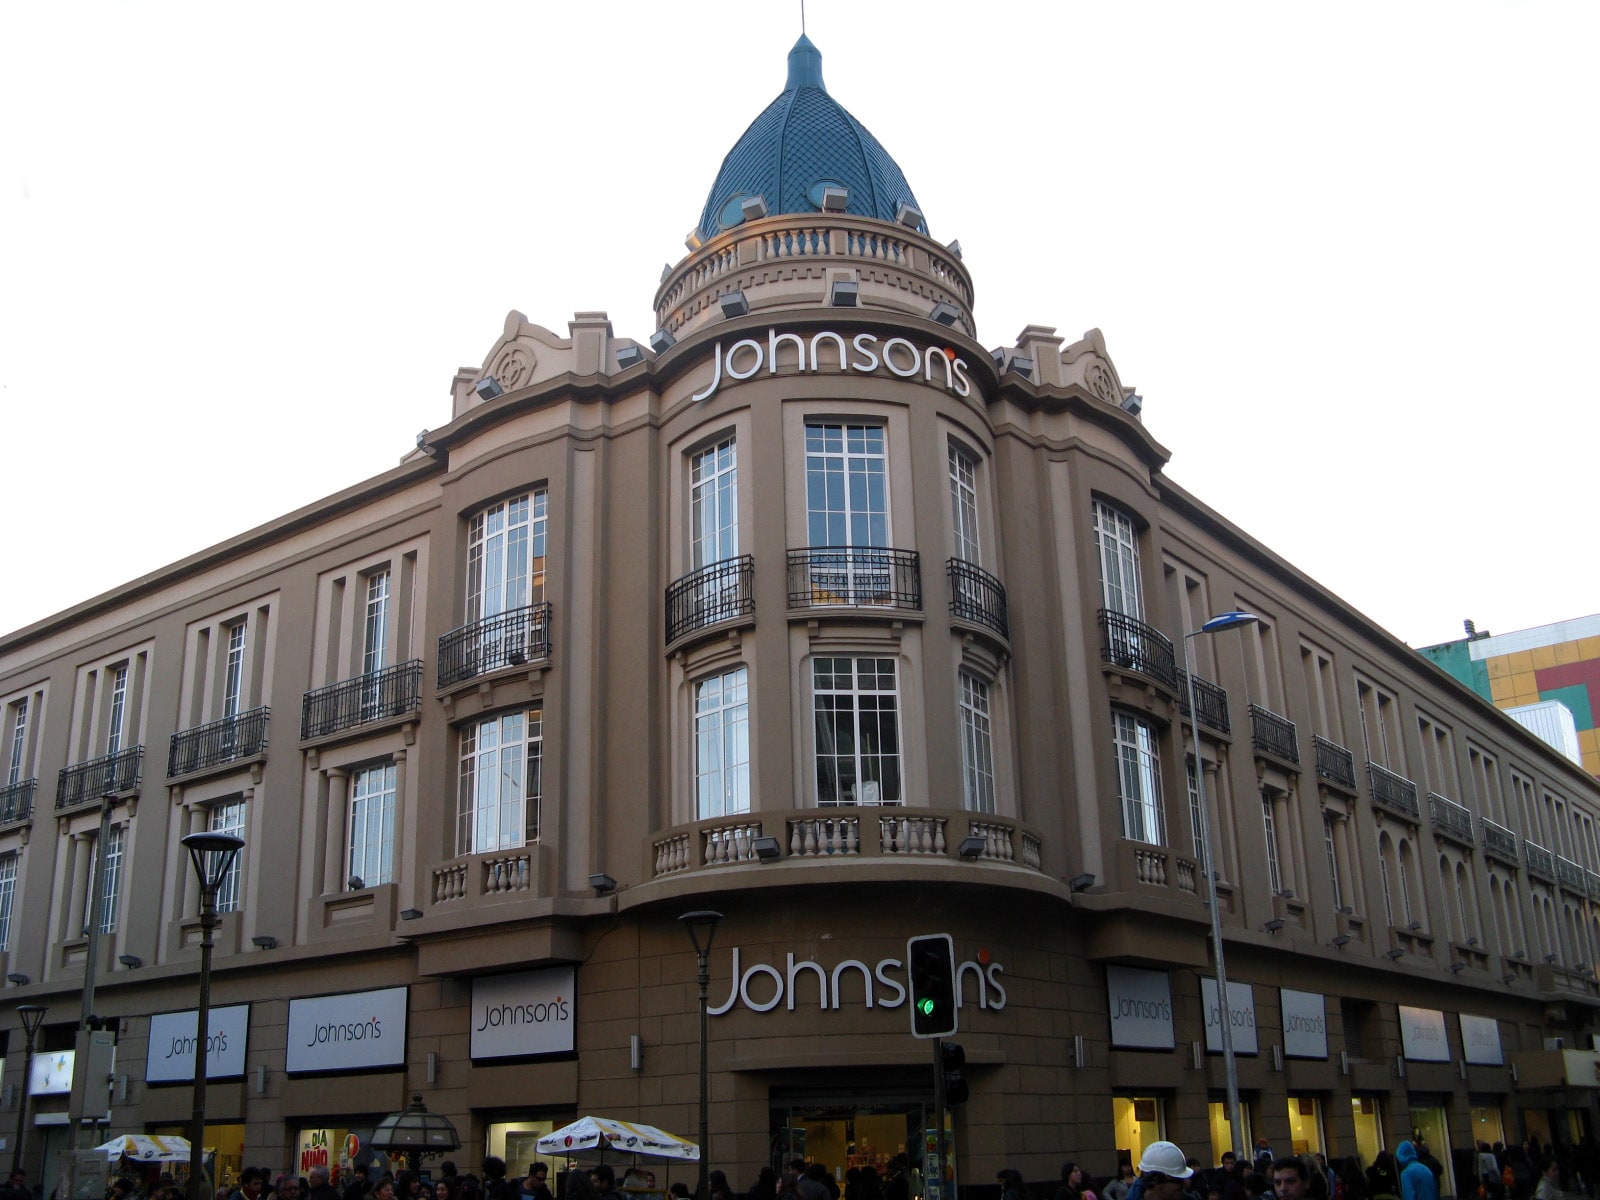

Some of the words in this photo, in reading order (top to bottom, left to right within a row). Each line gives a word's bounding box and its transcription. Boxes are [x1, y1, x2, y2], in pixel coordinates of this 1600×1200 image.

[692, 327, 971, 402] Johnson's
[706, 946, 1008, 1015] Johnsn's
[477, 995, 569, 1031] Johnson's
[1113, 996, 1170, 1021] Johnson's
[166, 1030, 229, 1059] Johnon's
[307, 1016, 381, 1047] Johnson's
